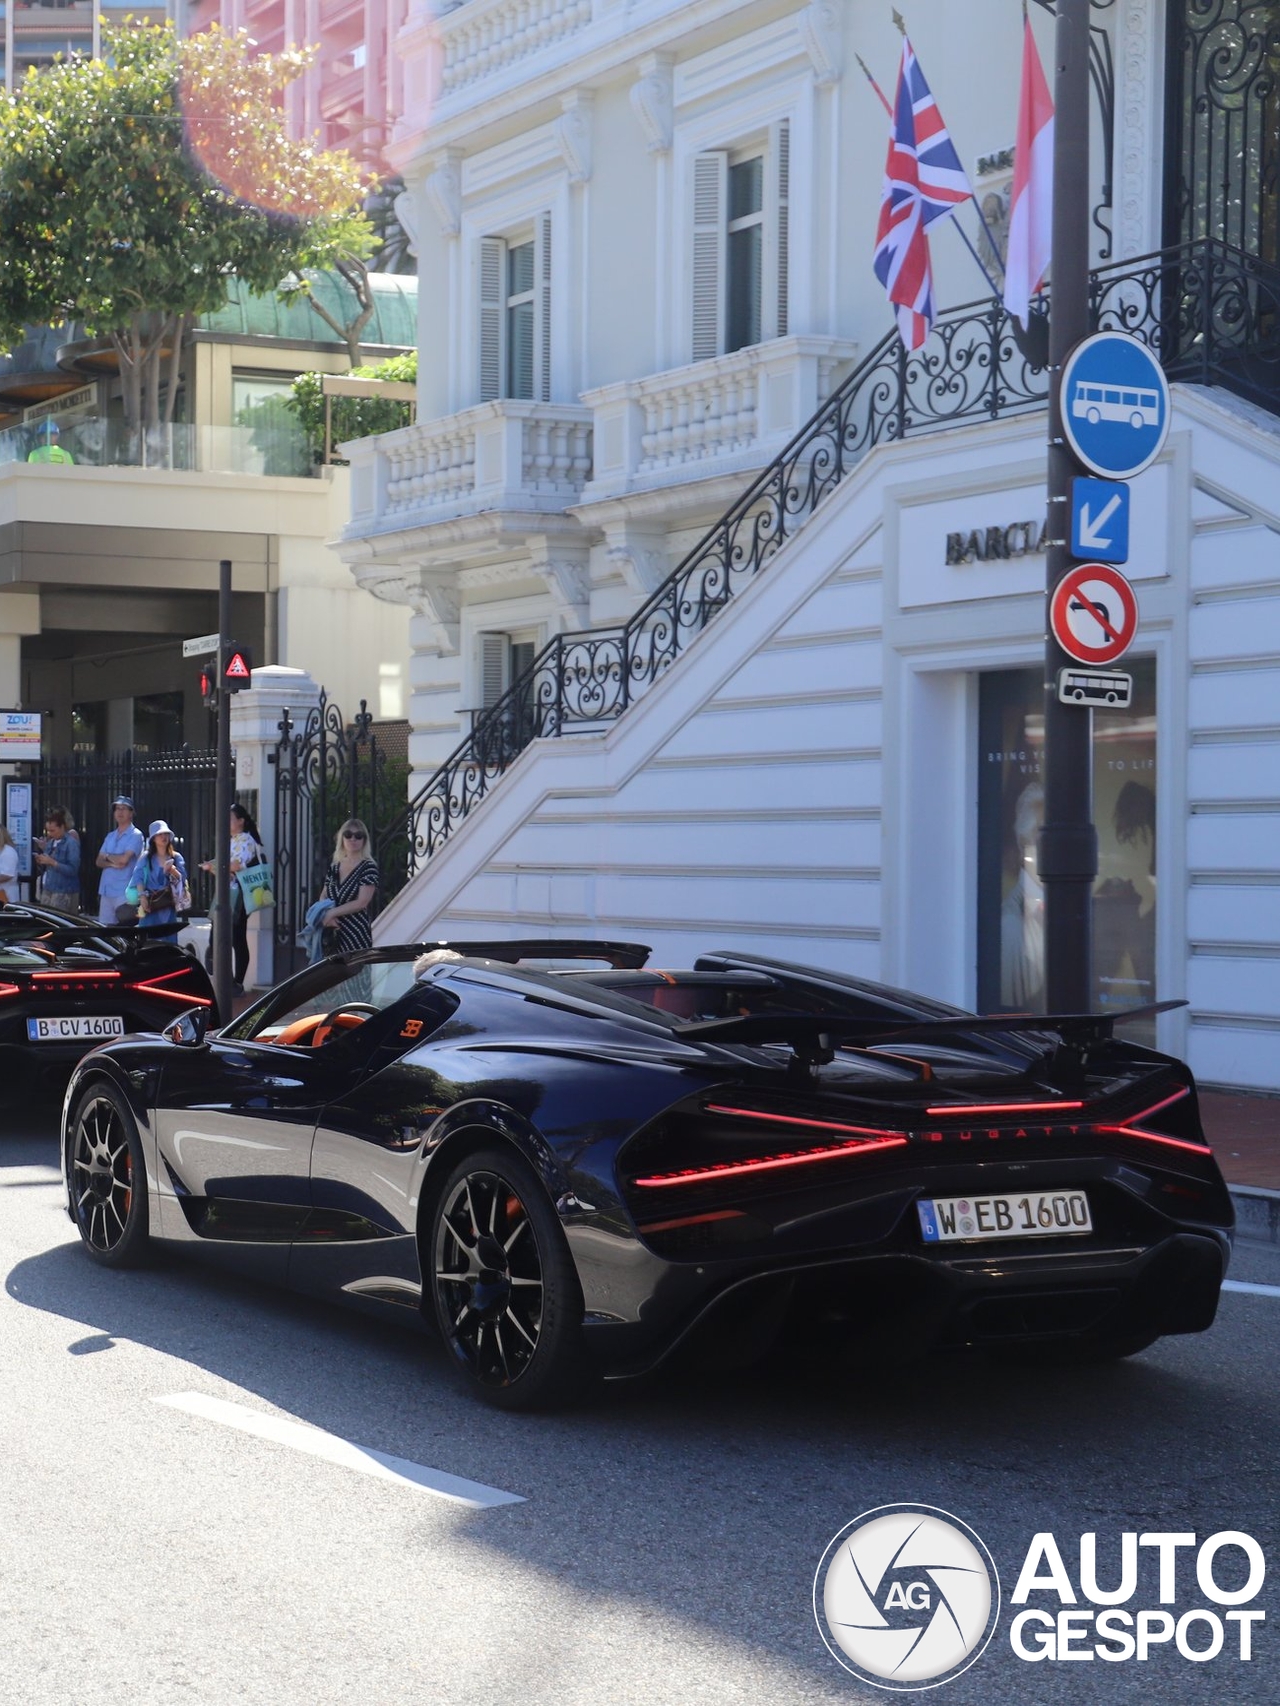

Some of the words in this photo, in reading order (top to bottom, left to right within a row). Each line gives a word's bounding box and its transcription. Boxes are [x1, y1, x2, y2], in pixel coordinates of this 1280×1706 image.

[7, 714, 32, 725] ZOU!
[1107, 760, 1126, 771] TO
[39, 1021, 49, 1037] B
[60, 1020, 80, 1036] CV
[83, 1018, 122, 1035] 1600
[926, 1225, 934, 1235] D
[936, 1202, 957, 1235] W
[974, 1199, 1014, 1232] EB
[1018, 1195, 1088, 1229] 1600
